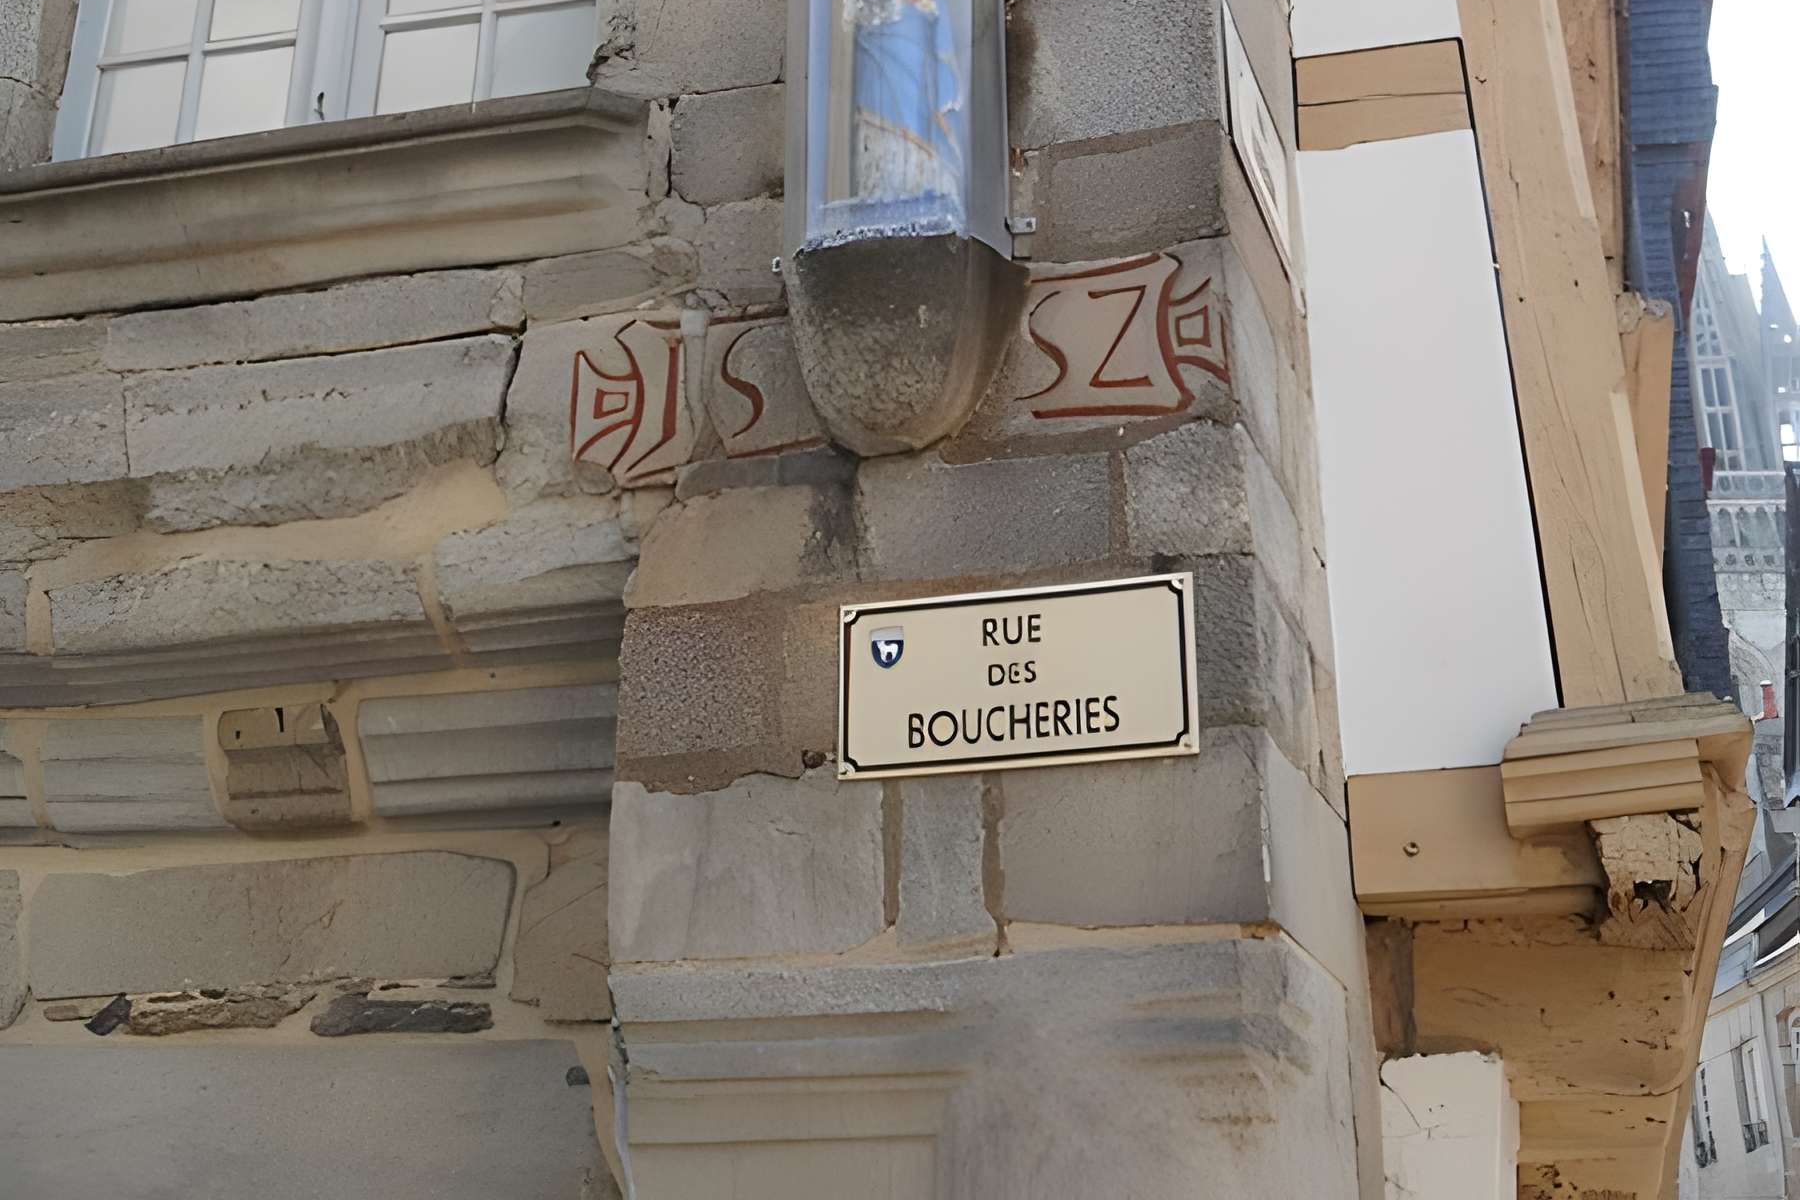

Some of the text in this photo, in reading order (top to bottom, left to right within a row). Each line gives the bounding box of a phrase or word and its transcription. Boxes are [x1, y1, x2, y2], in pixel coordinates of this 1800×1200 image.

[982, 614, 1042, 646] RUE
[988, 661, 1037, 686] DES
[908, 695, 1120, 749] BOUCHERIES
